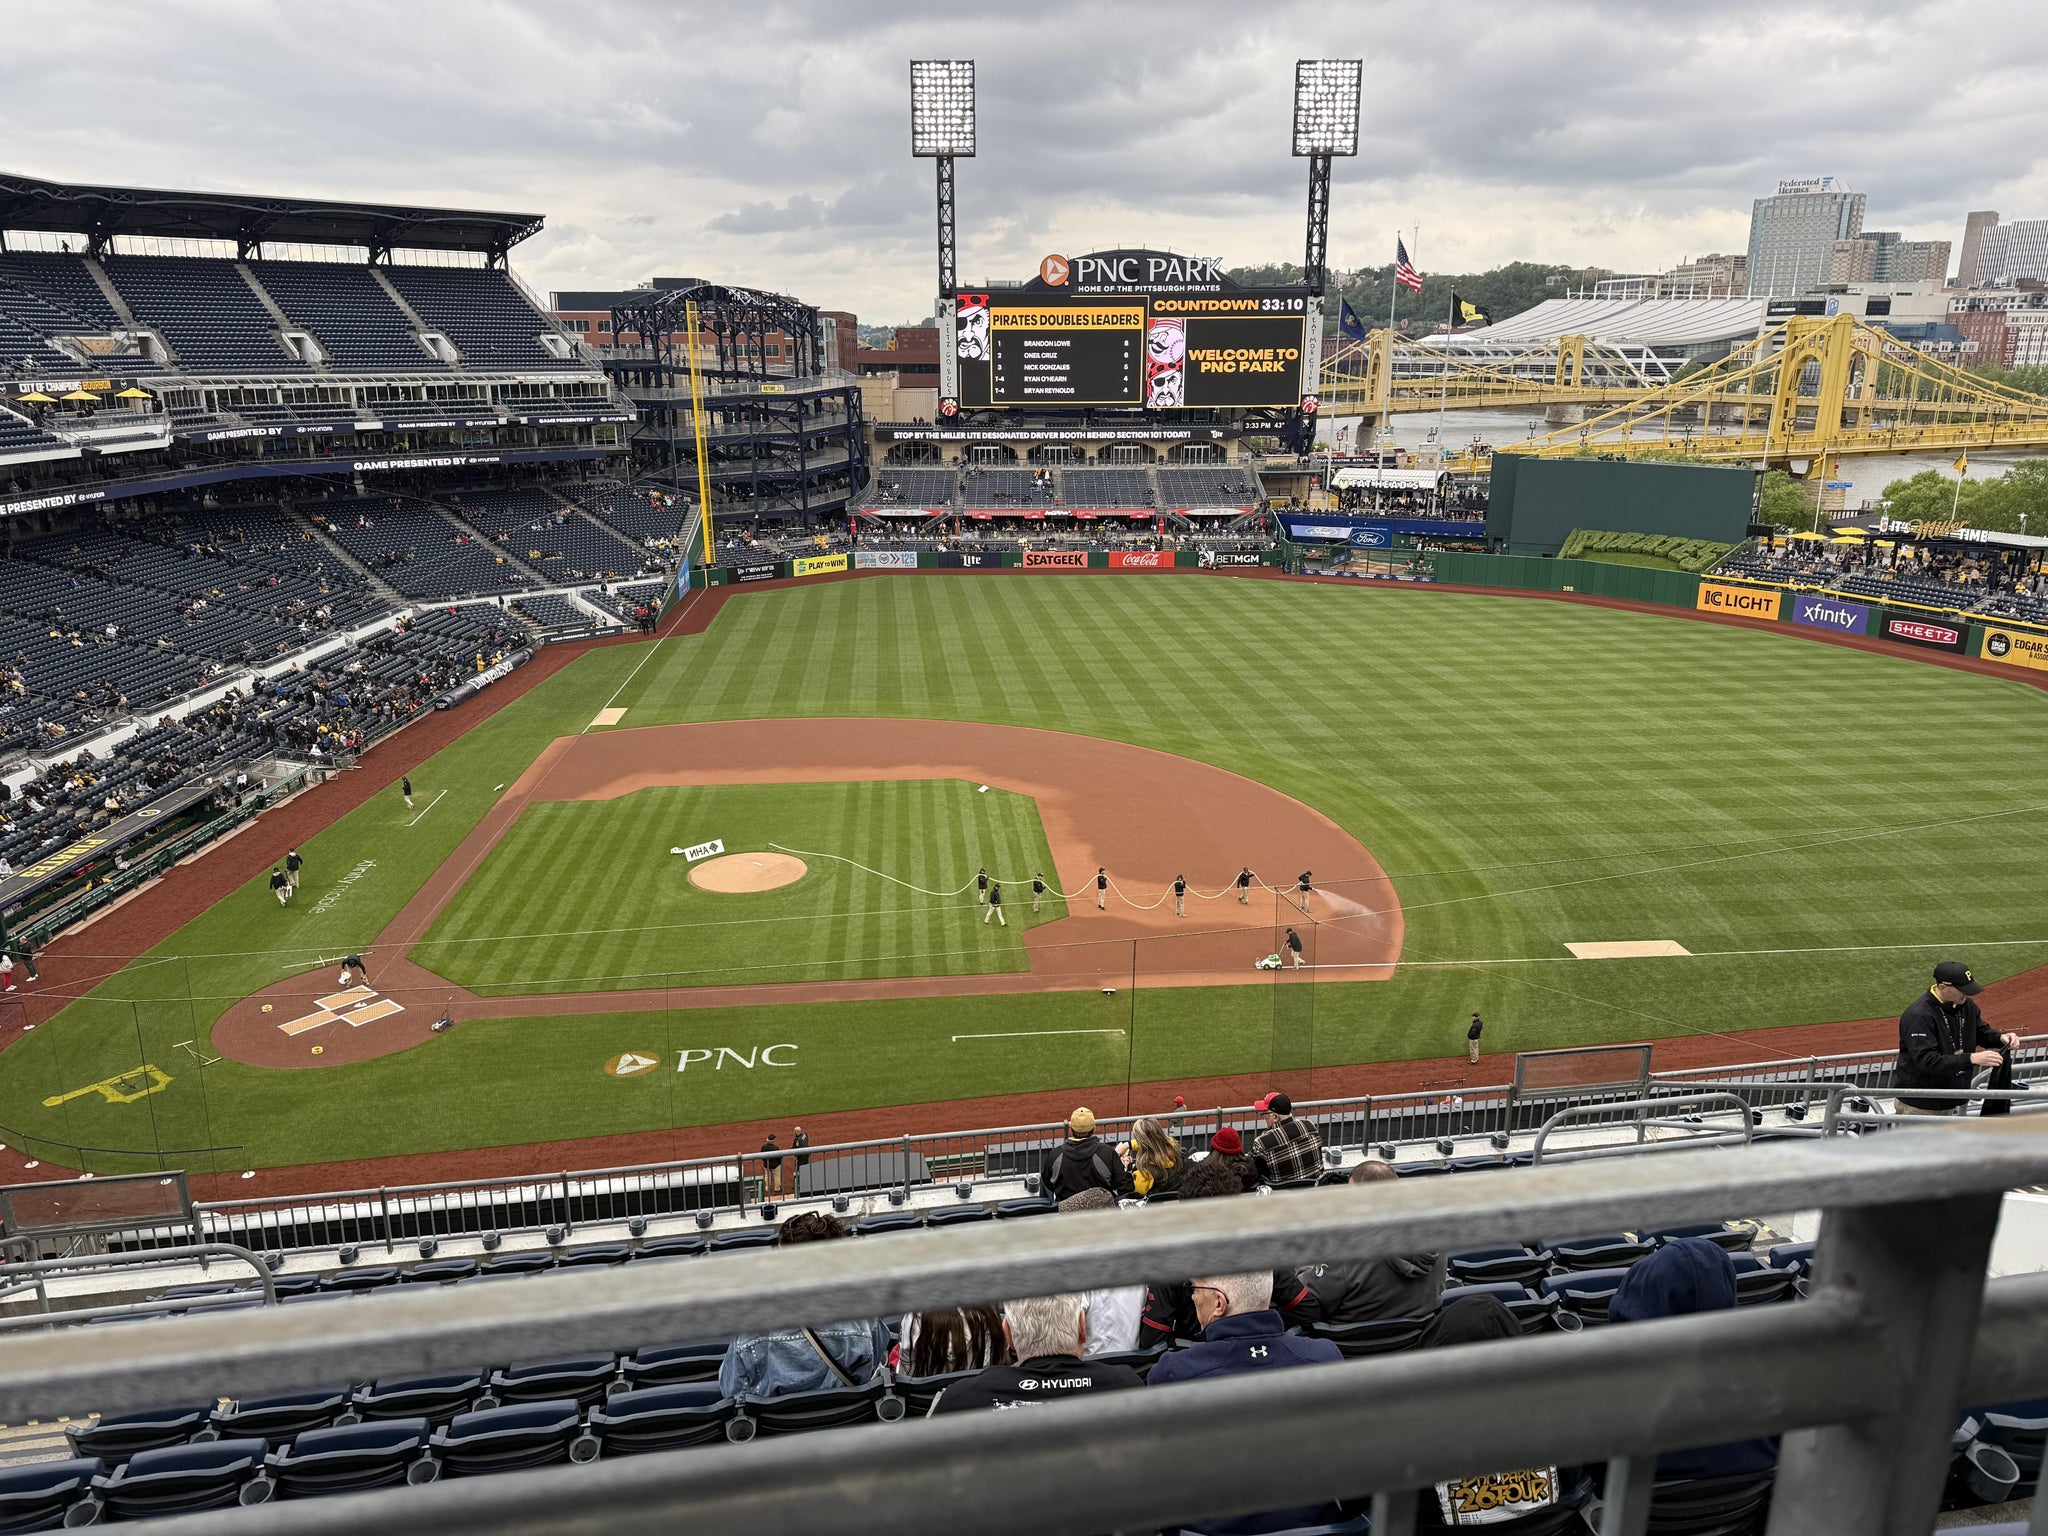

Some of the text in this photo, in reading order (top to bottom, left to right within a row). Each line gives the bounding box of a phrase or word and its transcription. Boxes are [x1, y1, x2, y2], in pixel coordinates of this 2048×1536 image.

[1780, 177, 1820, 188] Federated
[1075, 257, 1223, 283] PNC PARK
[1187, 284, 1221, 292] PIRATES
[1153, 298, 1303, 312] COUNTDOWN 33:10
[992, 313, 1140, 326] PIRATES DOUBLES LEADERS
[1188, 348, 1299, 361] WELCOME TO
[1200, 361, 1285, 373] PNC PARK
[19, 380, 111, 393] CITY OF CHAMPIONS BOURBON
[207, 431, 226, 441] GAME
[226, 428, 267, 439] PRESENTED
[268, 427, 283, 435] BY
[1060, 431, 1086, 439] BOOTH
[1087, 431, 1116, 439] BEHIND
[1116, 431, 1150, 439] SECTION
[1163, 430, 1191, 438] TODAY!
[354, 461, 389, 470] GAME
[390, 459, 452, 468] PRESENTED
[453, 457, 466, 465] BY
[1352, 480, 1419, 490] FAT HEAD'S
[7, 497, 63, 514] PRESENTED
[64, 494, 76, 504] BY
[1311, 527, 1333, 536] Ford
[1888, 520, 1911, 534] IT'S
[1908, 518, 1970, 541] Miller
[1960, 528, 1988, 542] TIME
[1356, 532, 1379, 544] Ford
[808, 561, 825, 570] PLAY
[830, 559, 846, 568] WIN!
[901, 553, 916, 565] 125
[962, 554, 982, 568] Lite
[1026, 553, 1084, 566] SEATGEEK
[1216, 554, 1260, 563] BETMGM
[1704, 590, 1773, 612] IC LIGHT
[1803, 603, 1858, 628] xfinity
[1894, 623, 1954, 641] SHEETZ
[2014, 639, 2043, 652] EDGAR
[18, 839, 108, 878] PIRATES
[1964, 970, 1973, 981] P
[675, 1043, 799, 1073] PNC
[1042, 1377, 1092, 1389] HYUNDAI
[1490, 1478, 1548, 1506] TOUR
